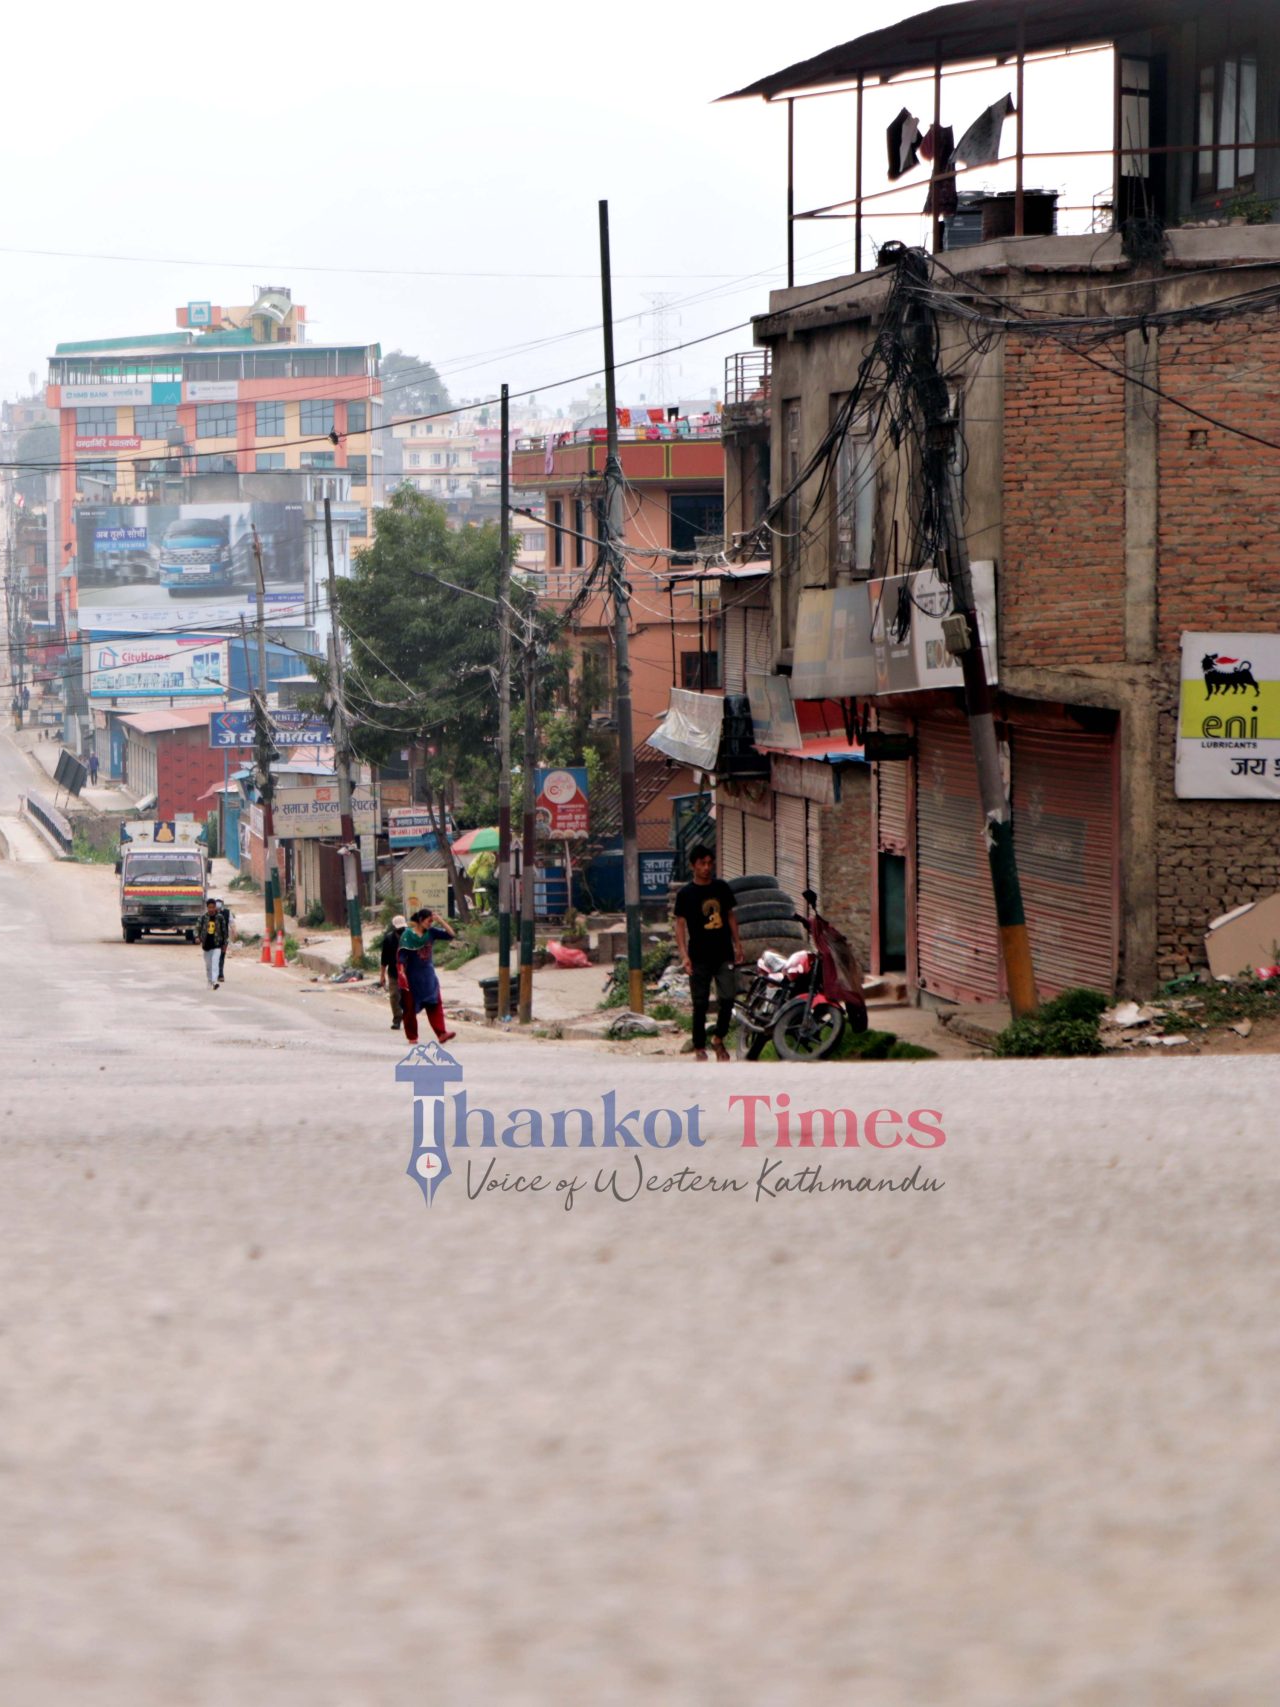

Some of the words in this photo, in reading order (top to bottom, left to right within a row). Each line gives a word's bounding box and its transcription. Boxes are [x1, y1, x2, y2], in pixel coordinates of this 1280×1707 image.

[90, 390, 109, 398] BANK
[1202, 705, 1258, 739] eni
[1201, 741, 1258, 749] LUBRICANTS
[1230, 758, 1267, 776] जय
